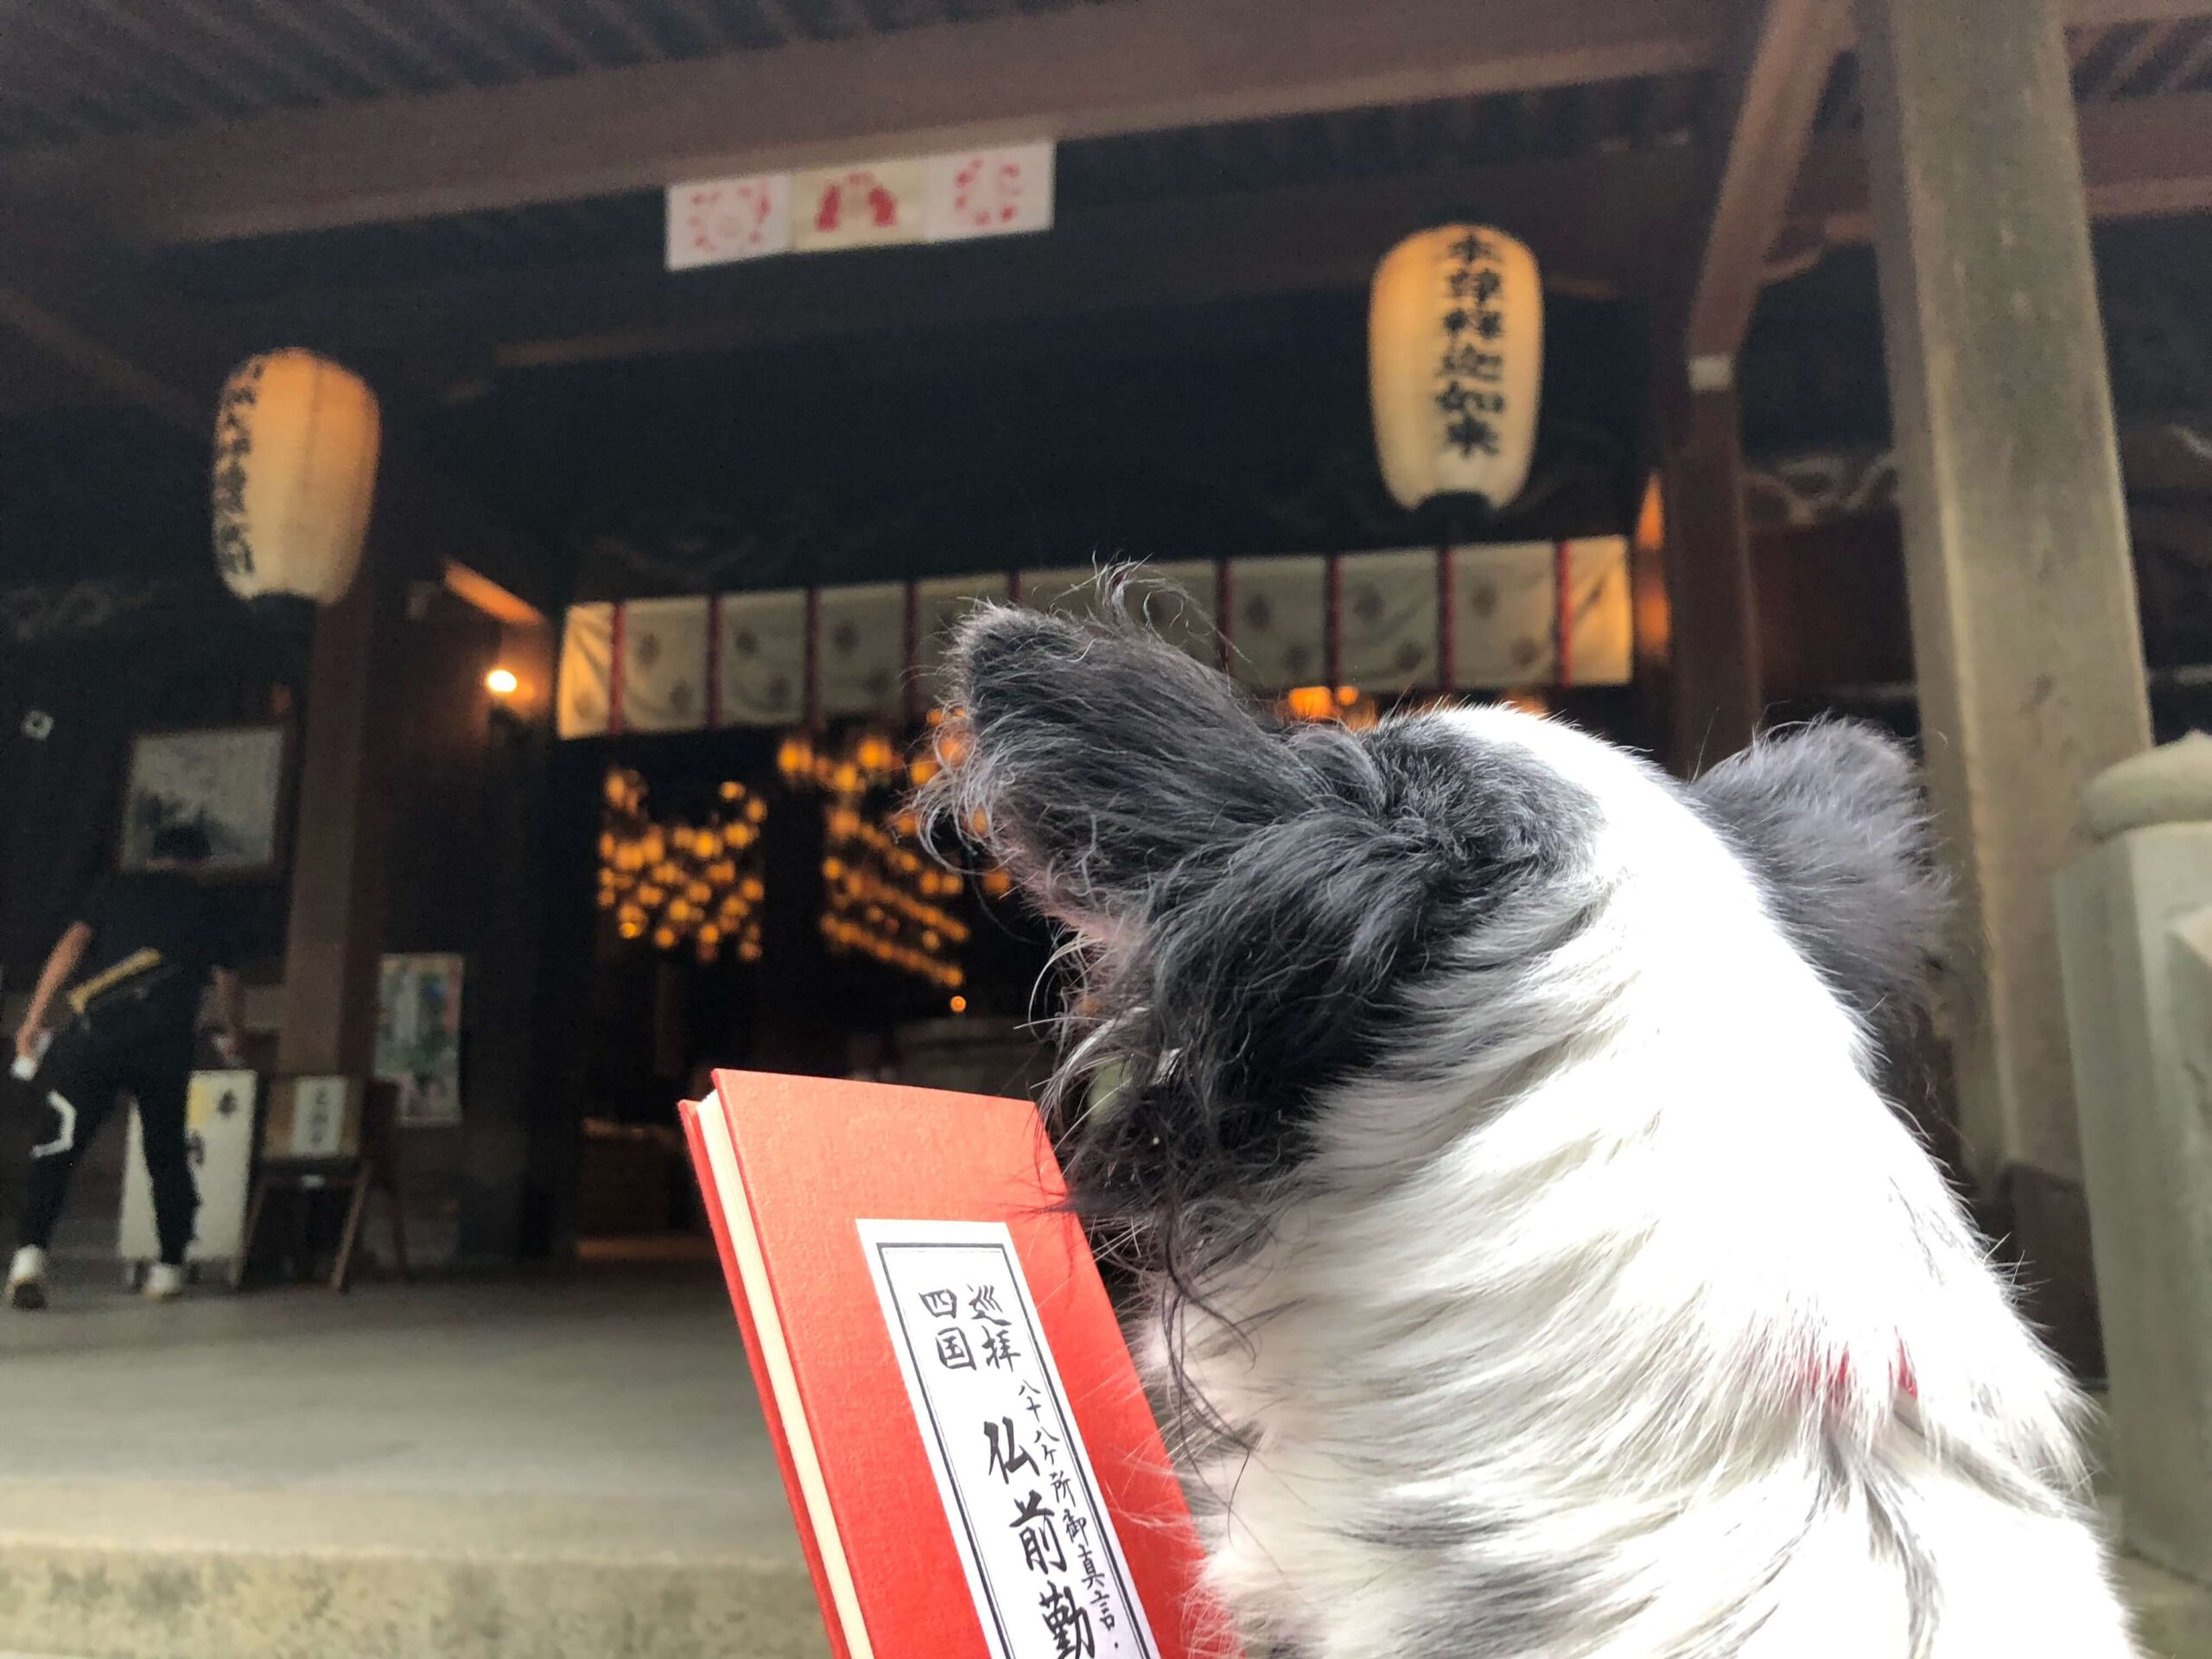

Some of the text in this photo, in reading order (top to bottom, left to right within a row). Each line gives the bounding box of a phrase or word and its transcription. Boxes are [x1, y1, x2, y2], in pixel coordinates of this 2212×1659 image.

[918, 1287, 977, 1371] 四国
[966, 1284, 1021, 1373] 巡拝
[983, 1415, 1096, 1659] 仏前勤
